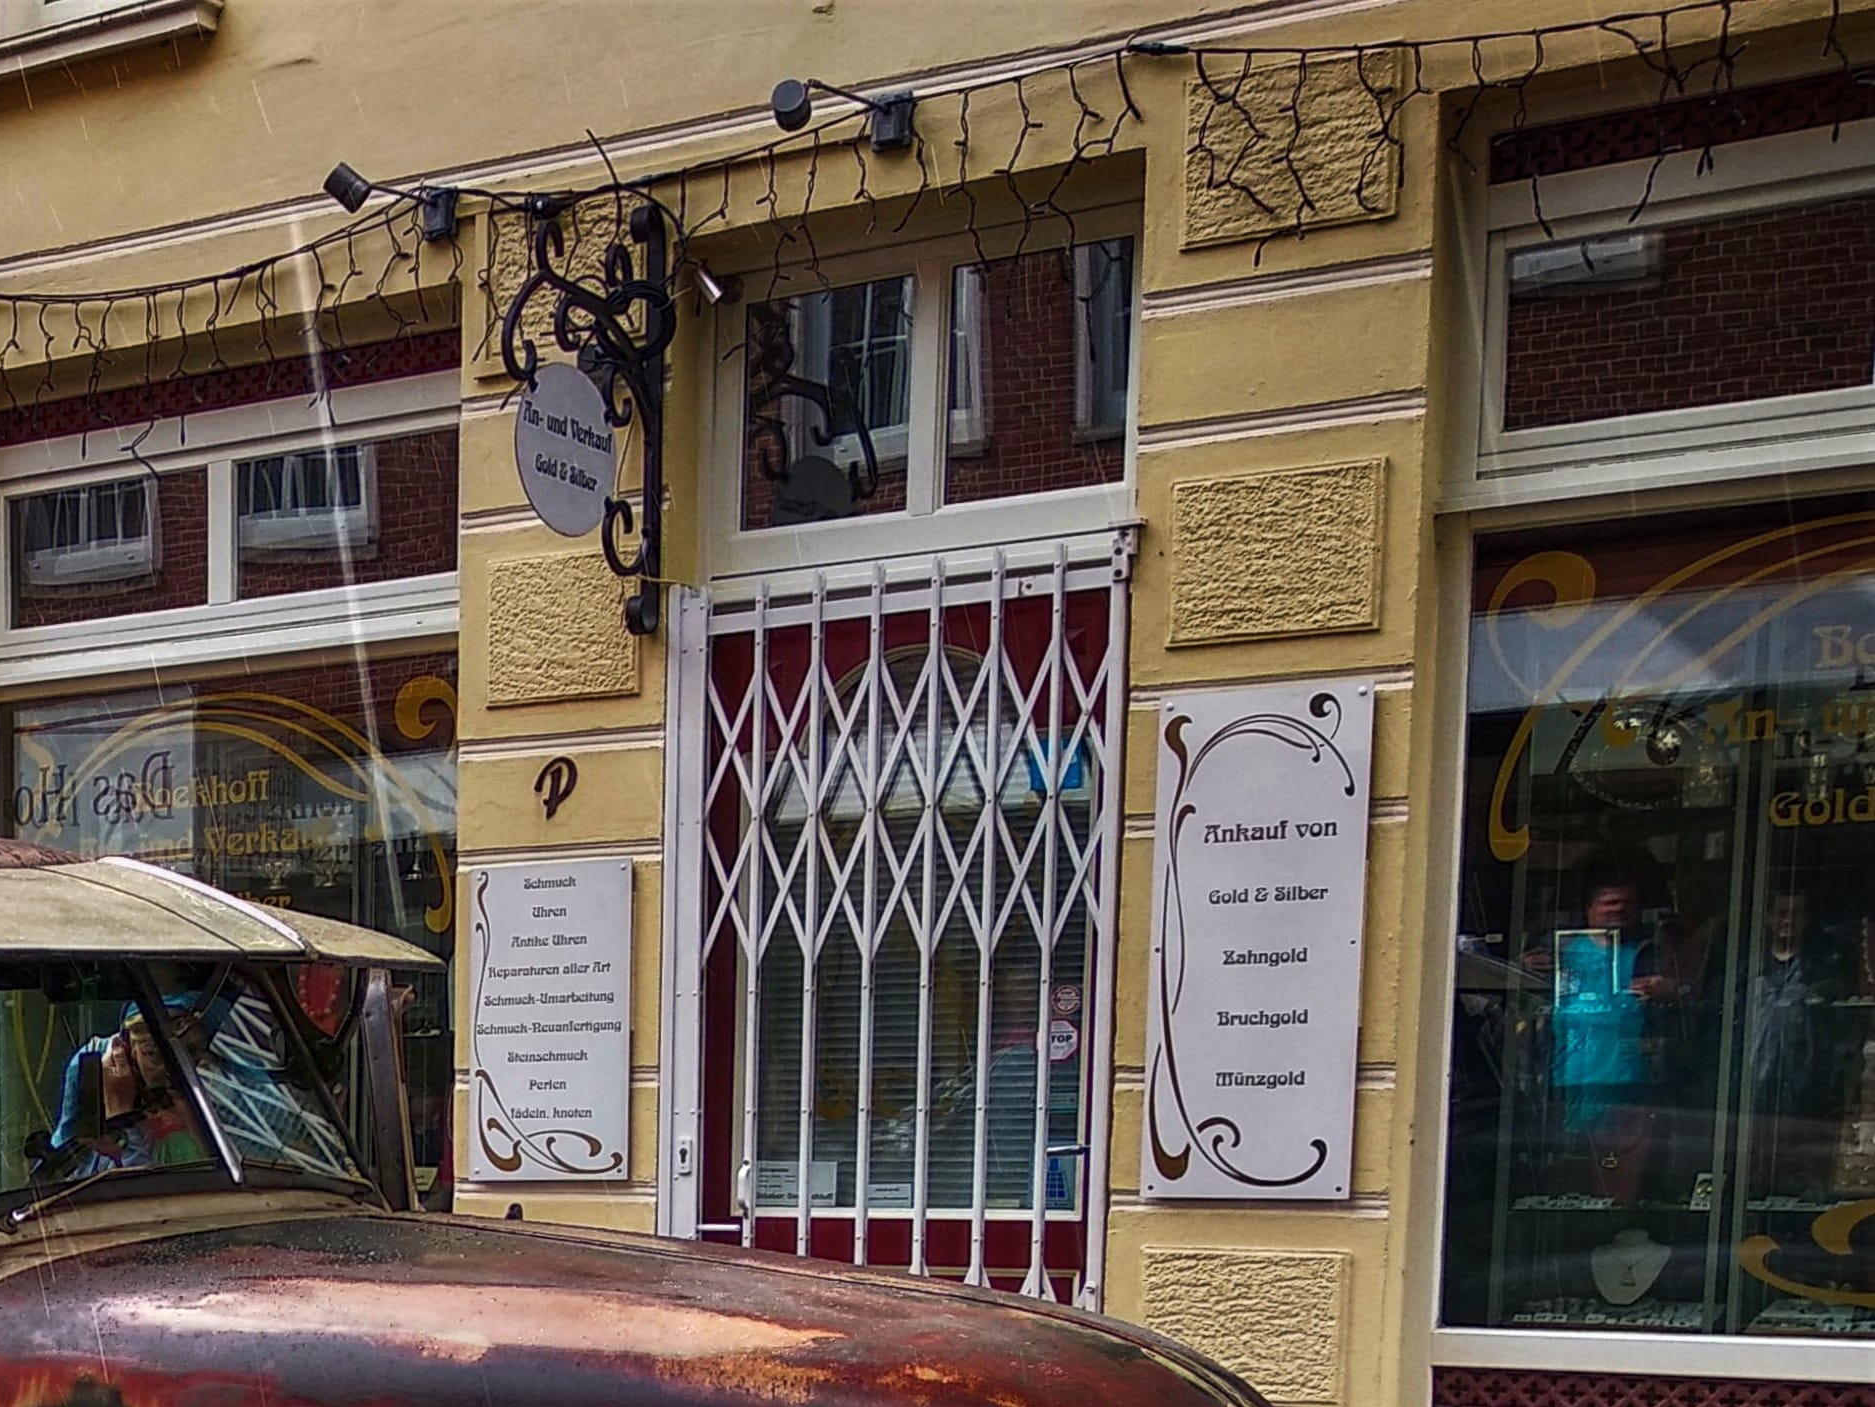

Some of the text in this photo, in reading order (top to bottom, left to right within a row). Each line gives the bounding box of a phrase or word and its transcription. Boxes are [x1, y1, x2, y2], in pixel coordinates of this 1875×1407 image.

[523, 400, 613, 454] An- und Verkauf
[535, 453, 598, 493] Gold & Silber
[1204, 820, 1337, 843] Ankauf von
[524, 876, 576, 890] Schmuck
[1208, 886, 1329, 905] Gold & Silber
[532, 906, 567, 918] Uhren
[511, 934, 587, 948] Antike Uhren
[1223, 947, 1308, 967] Zahngold
[488, 961, 611, 980] Reparaturen aller Art
[484, 992, 615, 1007] Schmuck-Umarbeitung
[1216, 1009, 1308, 1028] Bruchgold
[477, 1021, 622, 1036] Schmuck-Neuanfertigung
[1050, 1033, 1073, 1044] TOP
[507, 1050, 588, 1063] Steinschmuck
[529, 1079, 567, 1091] Perlen
[1215, 1070, 1306, 1089] Münzgold
[552, 1107, 592, 1119] knoten
